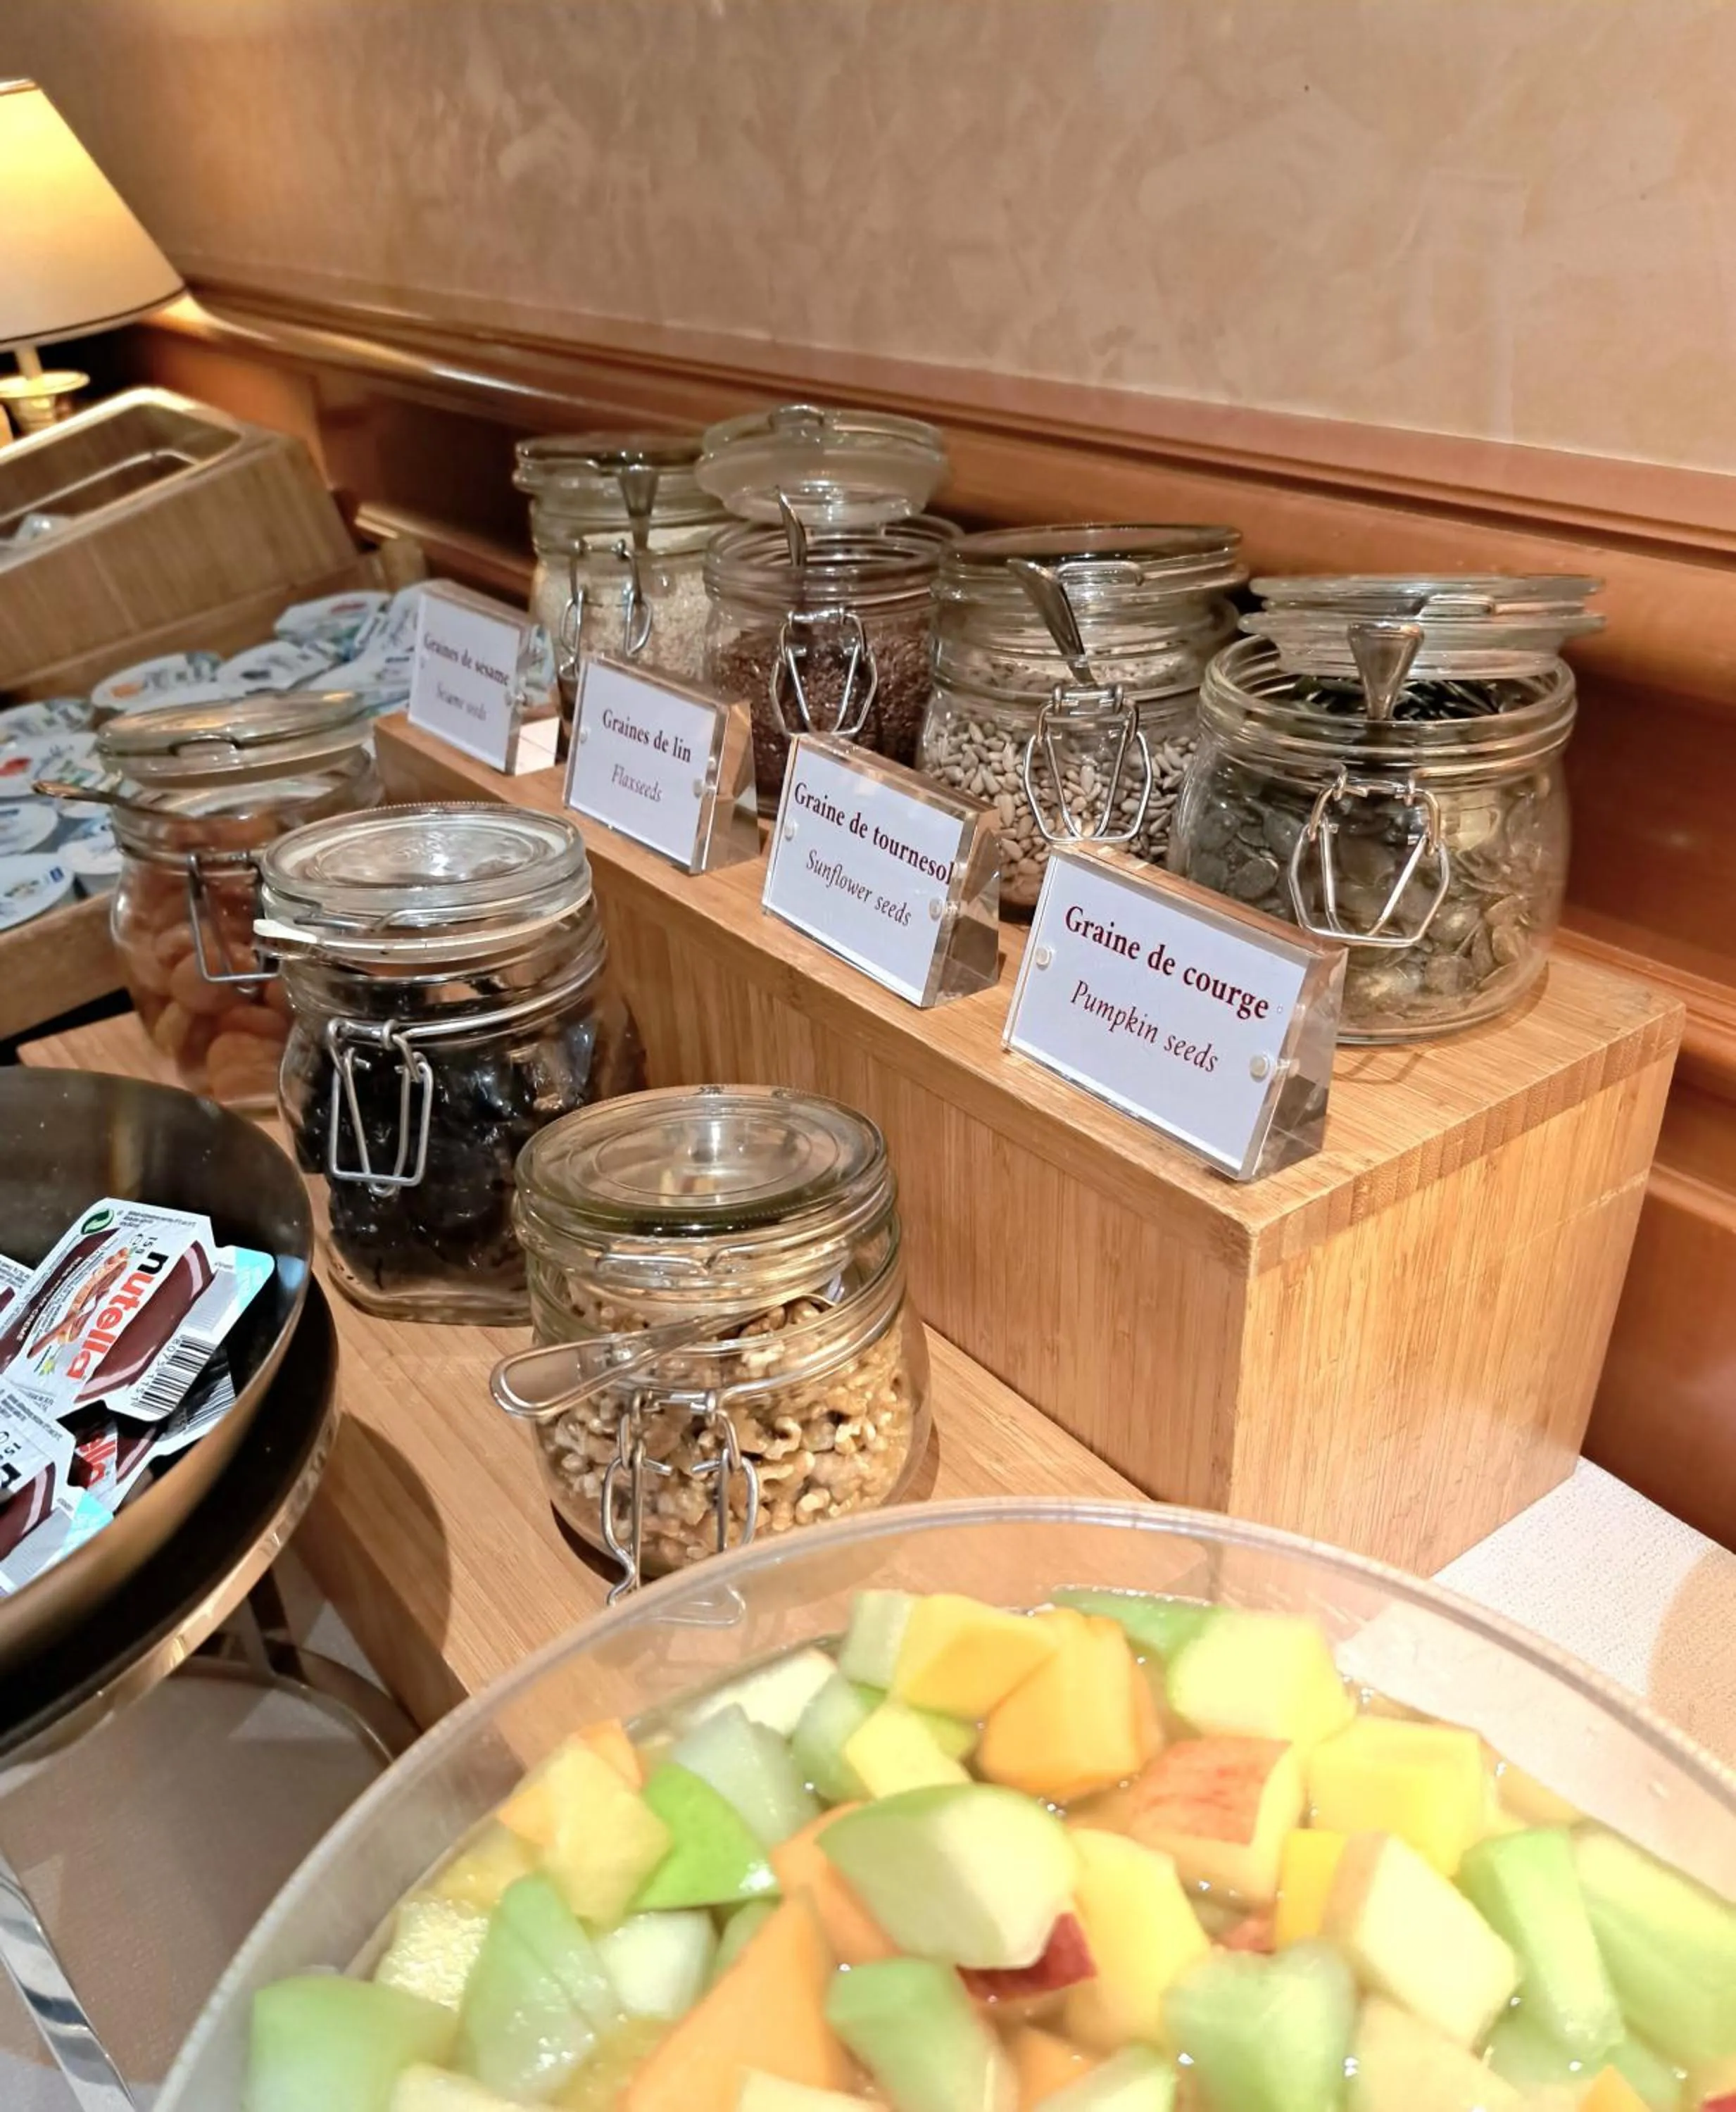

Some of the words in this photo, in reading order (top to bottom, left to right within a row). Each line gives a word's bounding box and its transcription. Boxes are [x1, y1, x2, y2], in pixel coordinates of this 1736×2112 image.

[424, 631, 458, 662] Graines
[461, 648, 472, 669] de
[603, 708, 650, 745] Graines
[653, 729, 669, 753] de
[672, 736, 691, 762] lin
[611, 763, 662, 803] Flaxseeds
[794, 781, 845, 826] Graine
[849, 812, 868, 839] de
[872, 825, 955, 886] tournesol
[805, 849, 873, 903] Sunflower
[874, 895, 912, 926] seeds
[1065, 905, 1141, 960] Graine
[1147, 943, 1176, 976] de
[1183, 966, 1269, 1020] courge
[1070, 979, 1159, 1043] Pumpkin
[1163, 1035, 1219, 1073] seeds
[67, 1251, 169, 1379] nutella
